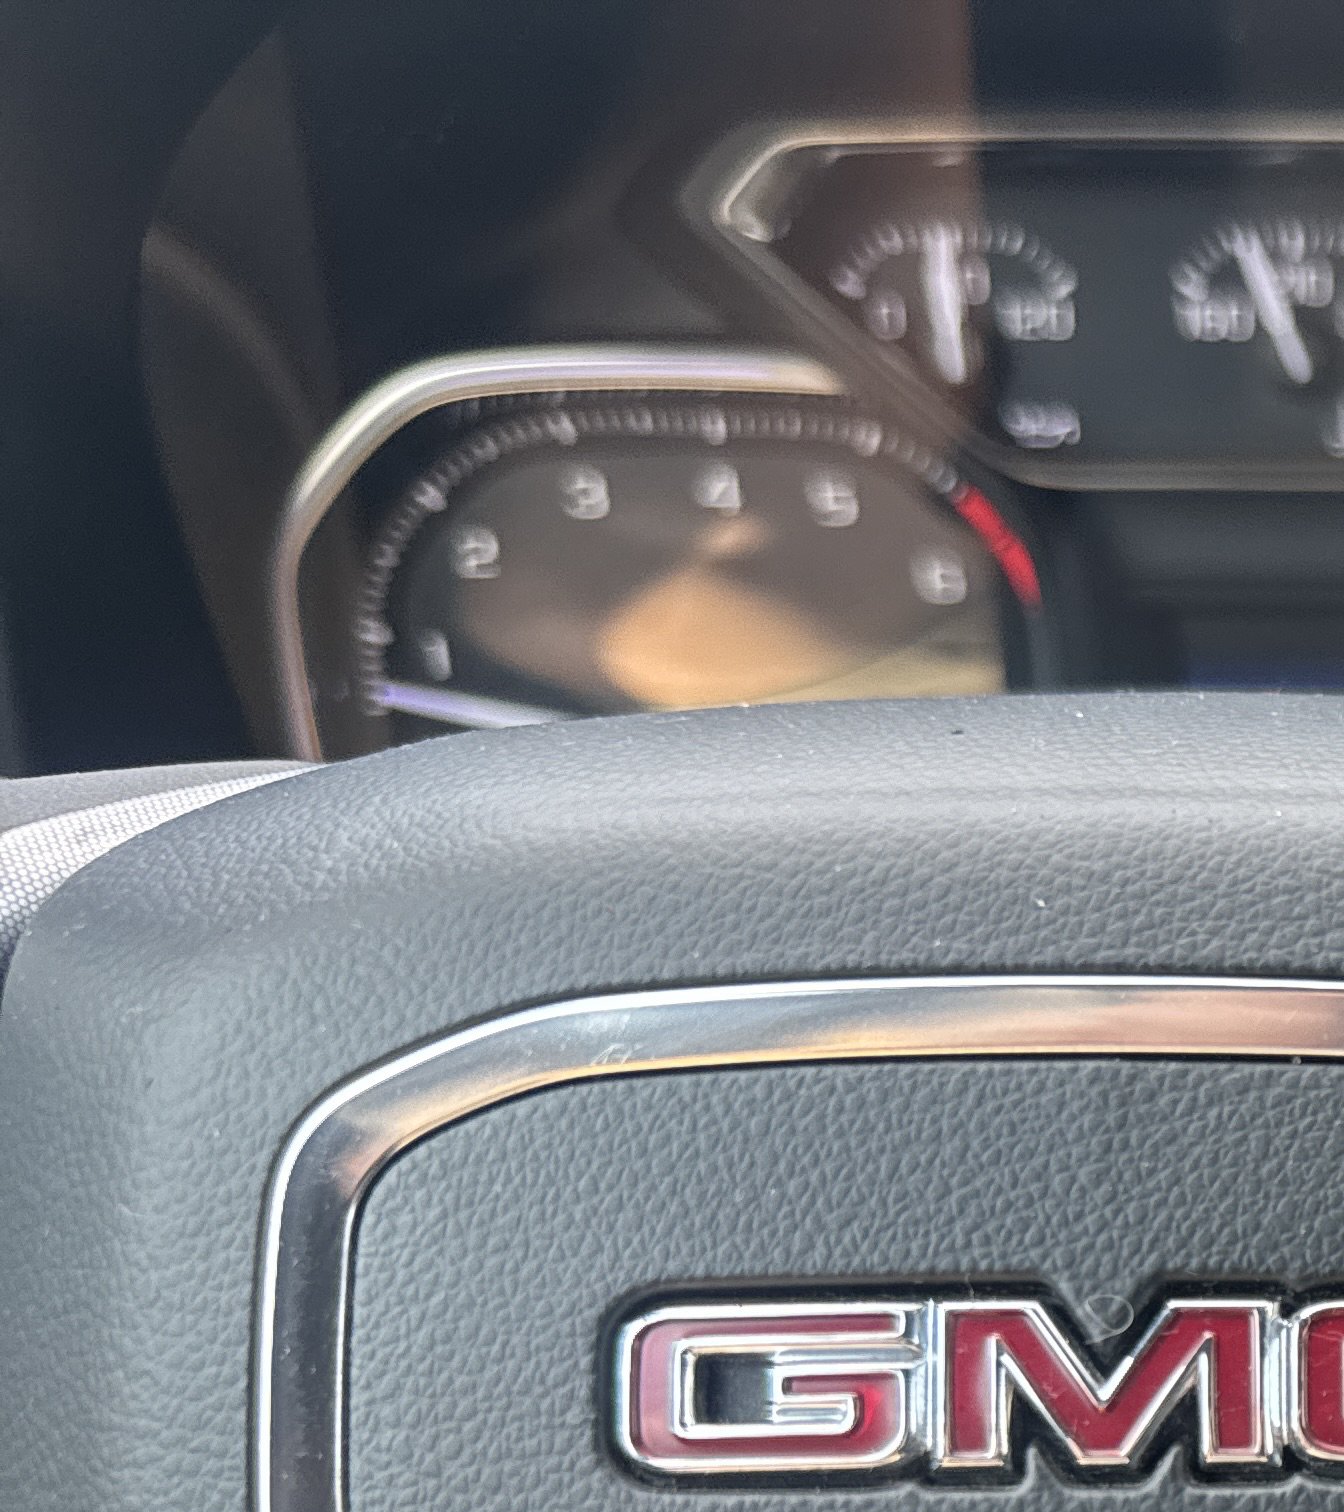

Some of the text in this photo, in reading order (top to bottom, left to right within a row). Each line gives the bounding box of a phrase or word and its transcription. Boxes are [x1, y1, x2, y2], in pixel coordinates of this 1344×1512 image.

[561, 464, 612, 520] 3
[692, 462, 743, 516] 4
[804, 466, 861, 528] 5
[450, 524, 501, 580] 2
[421, 627, 453, 683] 1
